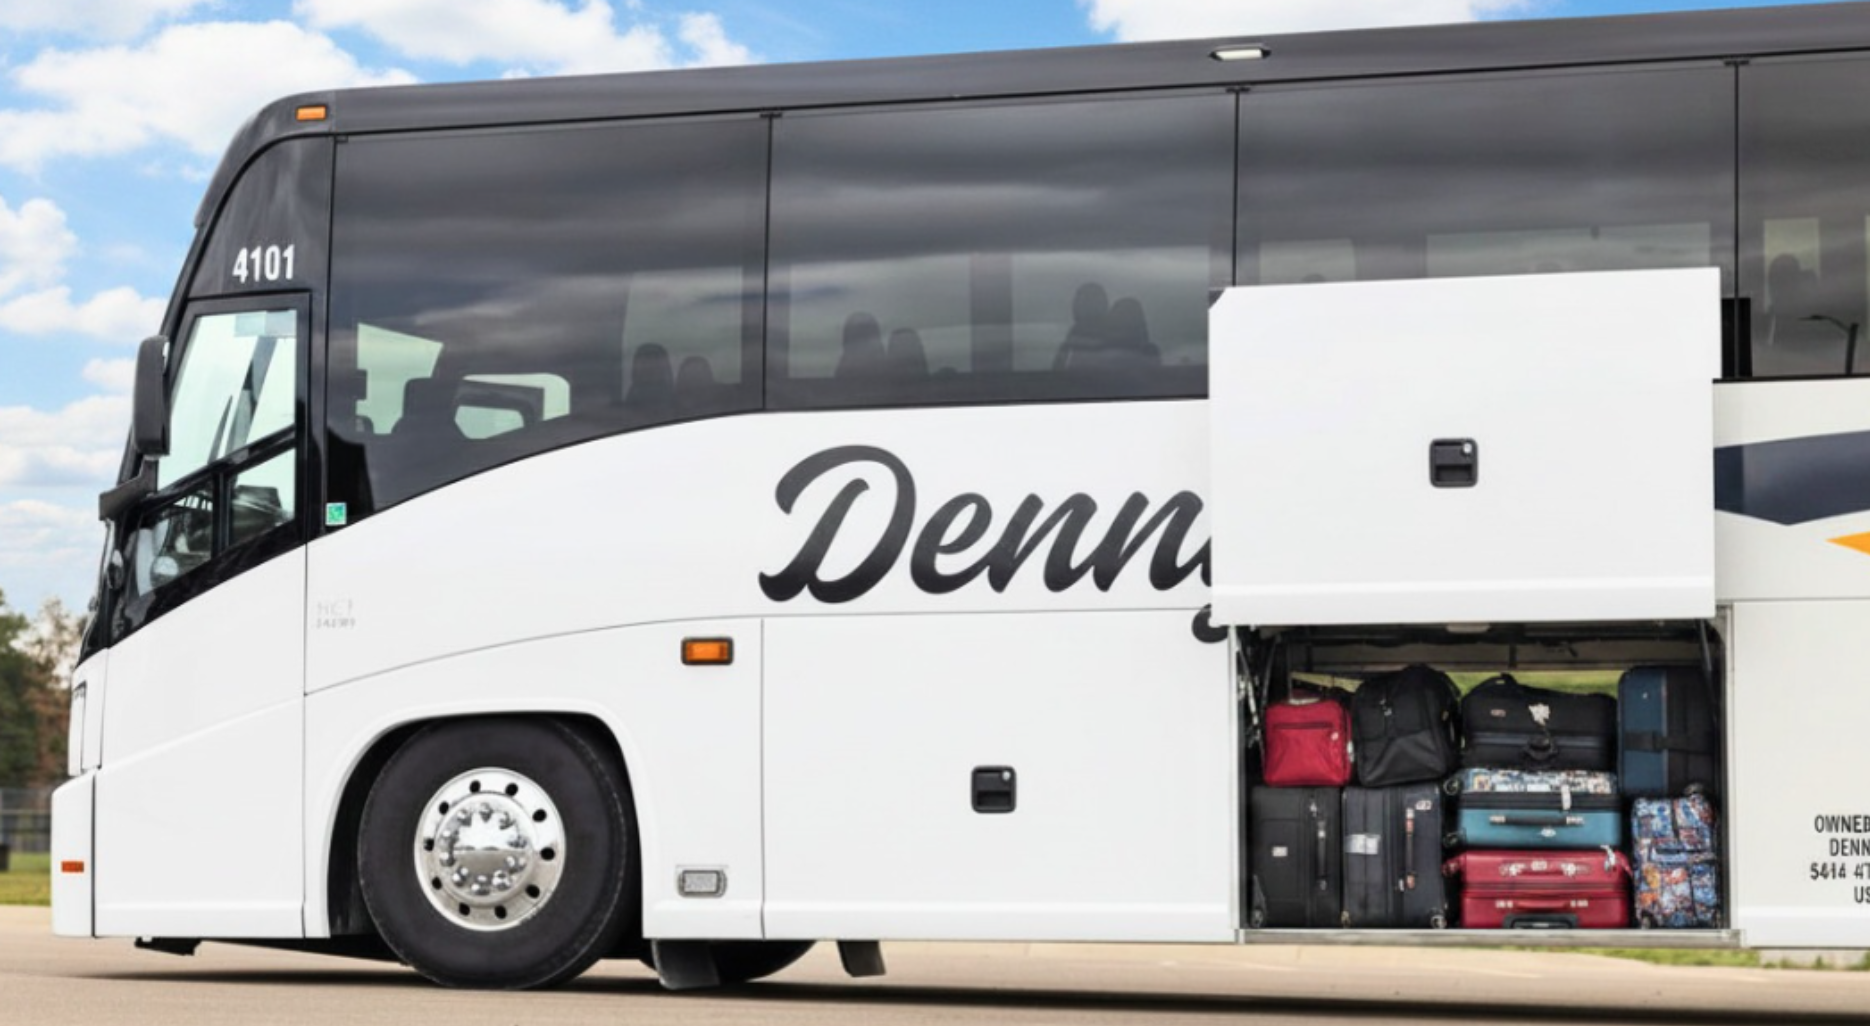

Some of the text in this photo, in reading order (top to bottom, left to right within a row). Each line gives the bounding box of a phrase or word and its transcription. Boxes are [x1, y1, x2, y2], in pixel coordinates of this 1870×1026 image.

[232, 244, 295, 283] 4101
[758, 444, 1229, 644] Denn
[1829, 838, 1870, 857] DENN
